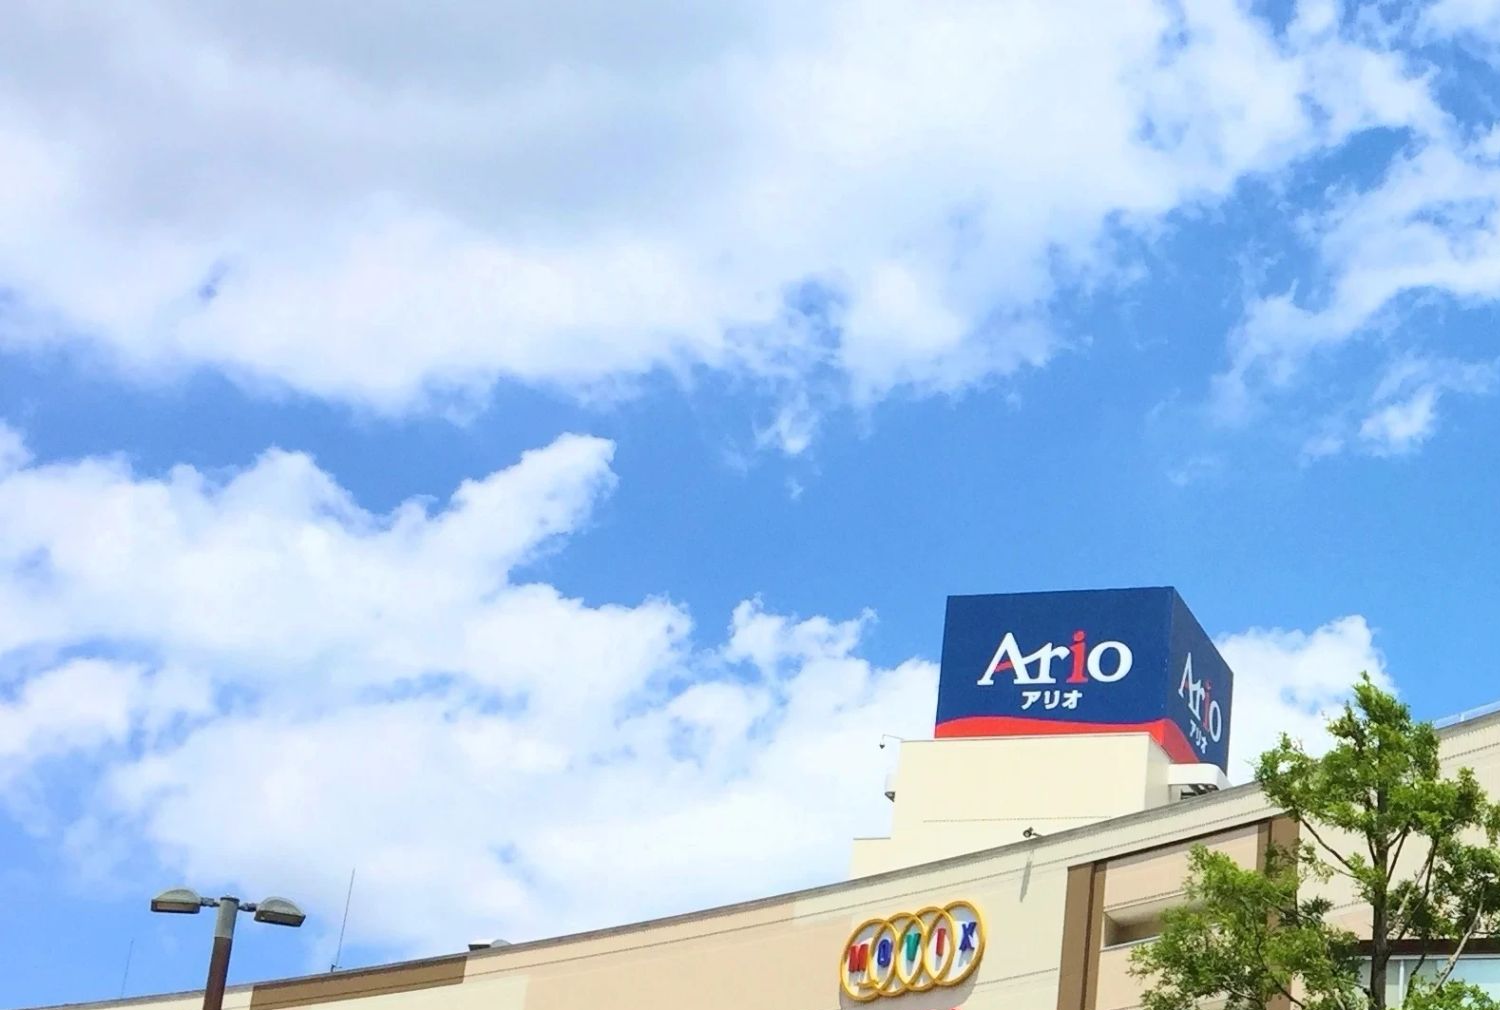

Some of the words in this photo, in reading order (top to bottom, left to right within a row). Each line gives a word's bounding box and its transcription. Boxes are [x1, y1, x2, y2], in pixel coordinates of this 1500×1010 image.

[977, 629, 1133, 686] Ario
[1021, 690, 1083, 710] アリオ
[1178, 651, 1222, 743] Ario
[848, 921, 978, 972] MOVIX
